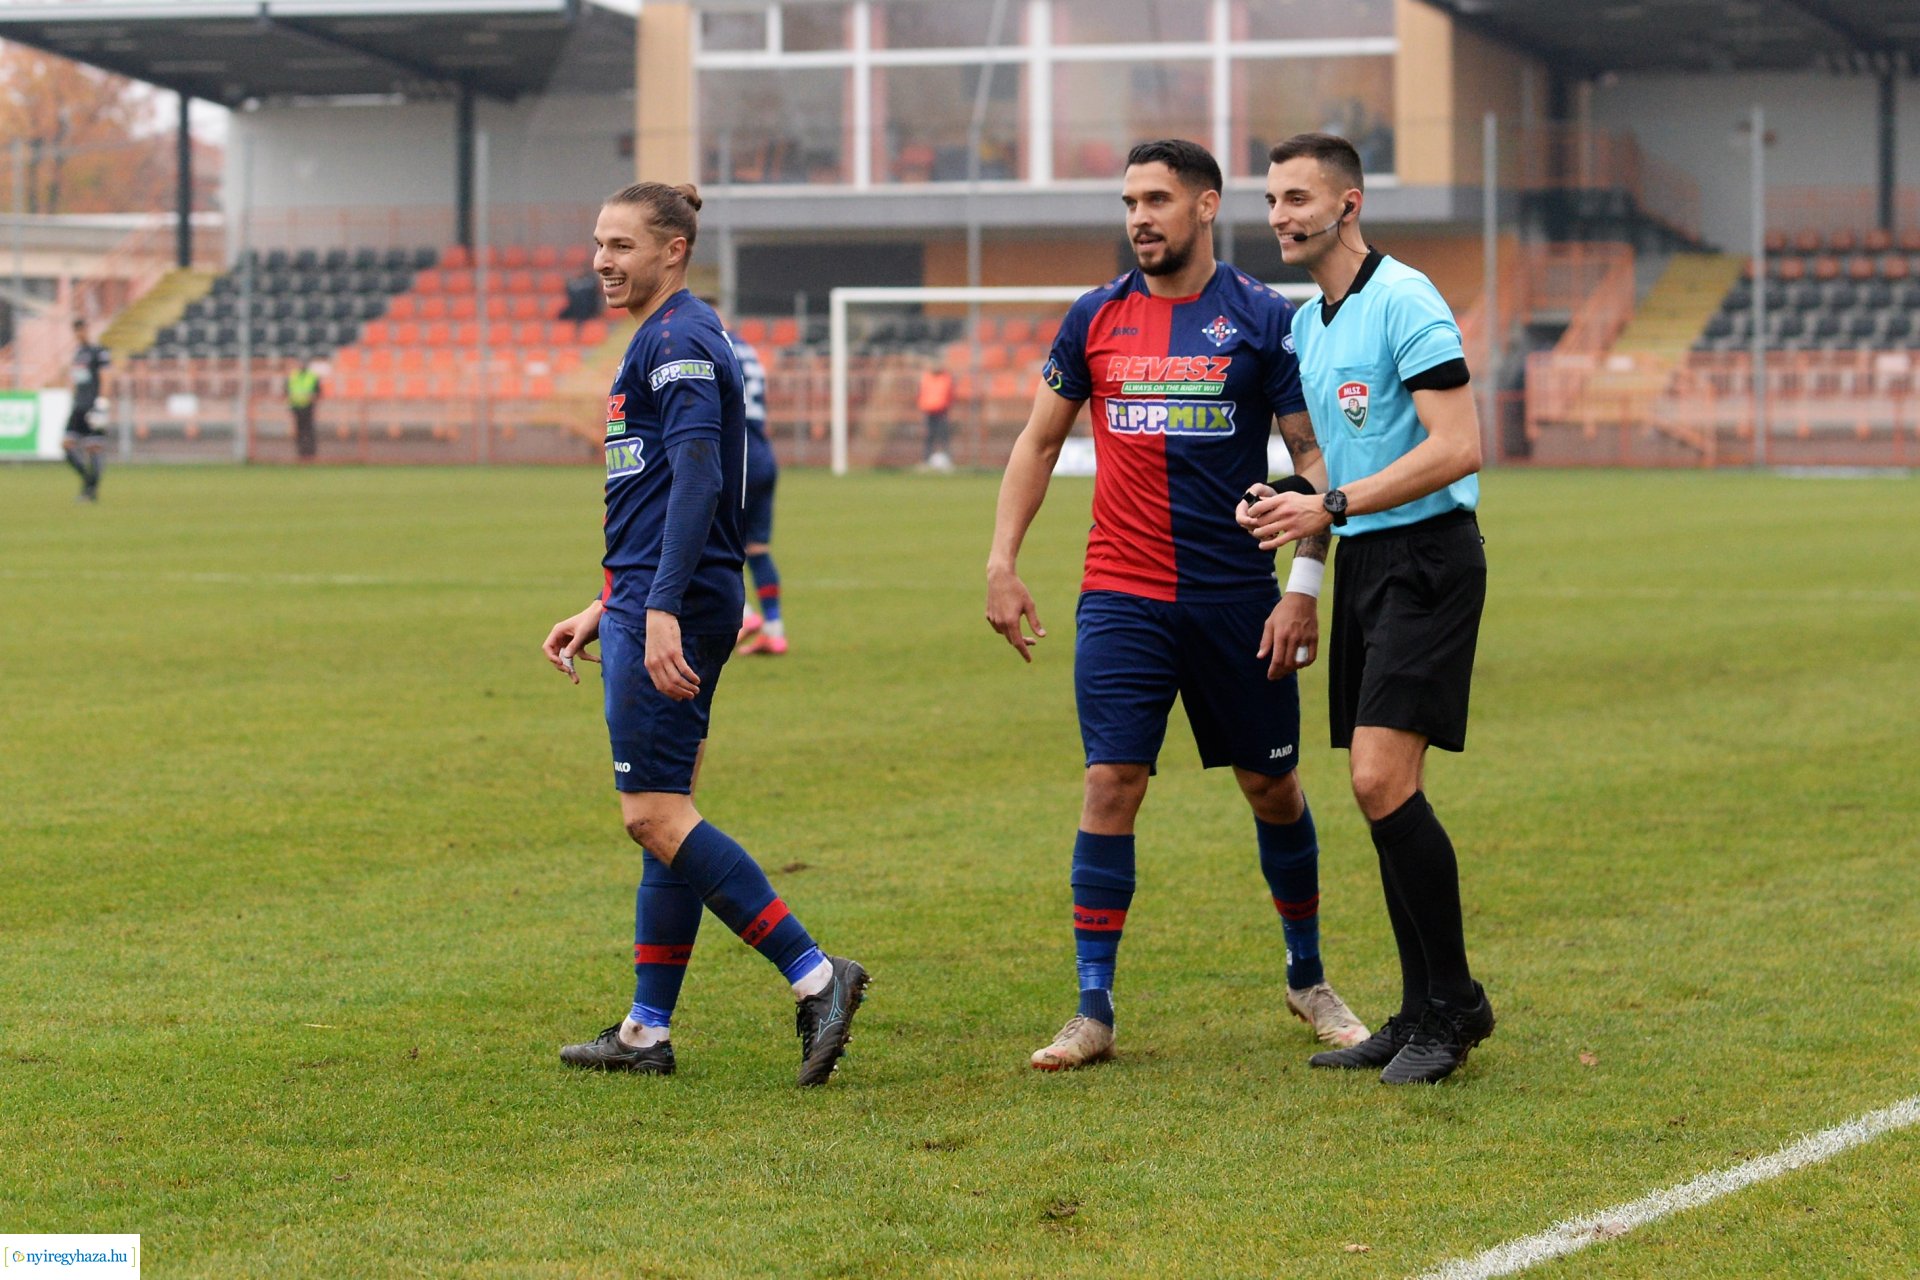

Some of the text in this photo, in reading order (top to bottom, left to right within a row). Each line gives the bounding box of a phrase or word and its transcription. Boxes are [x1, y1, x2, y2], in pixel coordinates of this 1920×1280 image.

[1106, 356, 1231, 382] REVESZ
[1123, 384, 1221, 393] ALWAYS ON THE RIGHT WAY
[1269, 744, 1293, 759] JAKO
